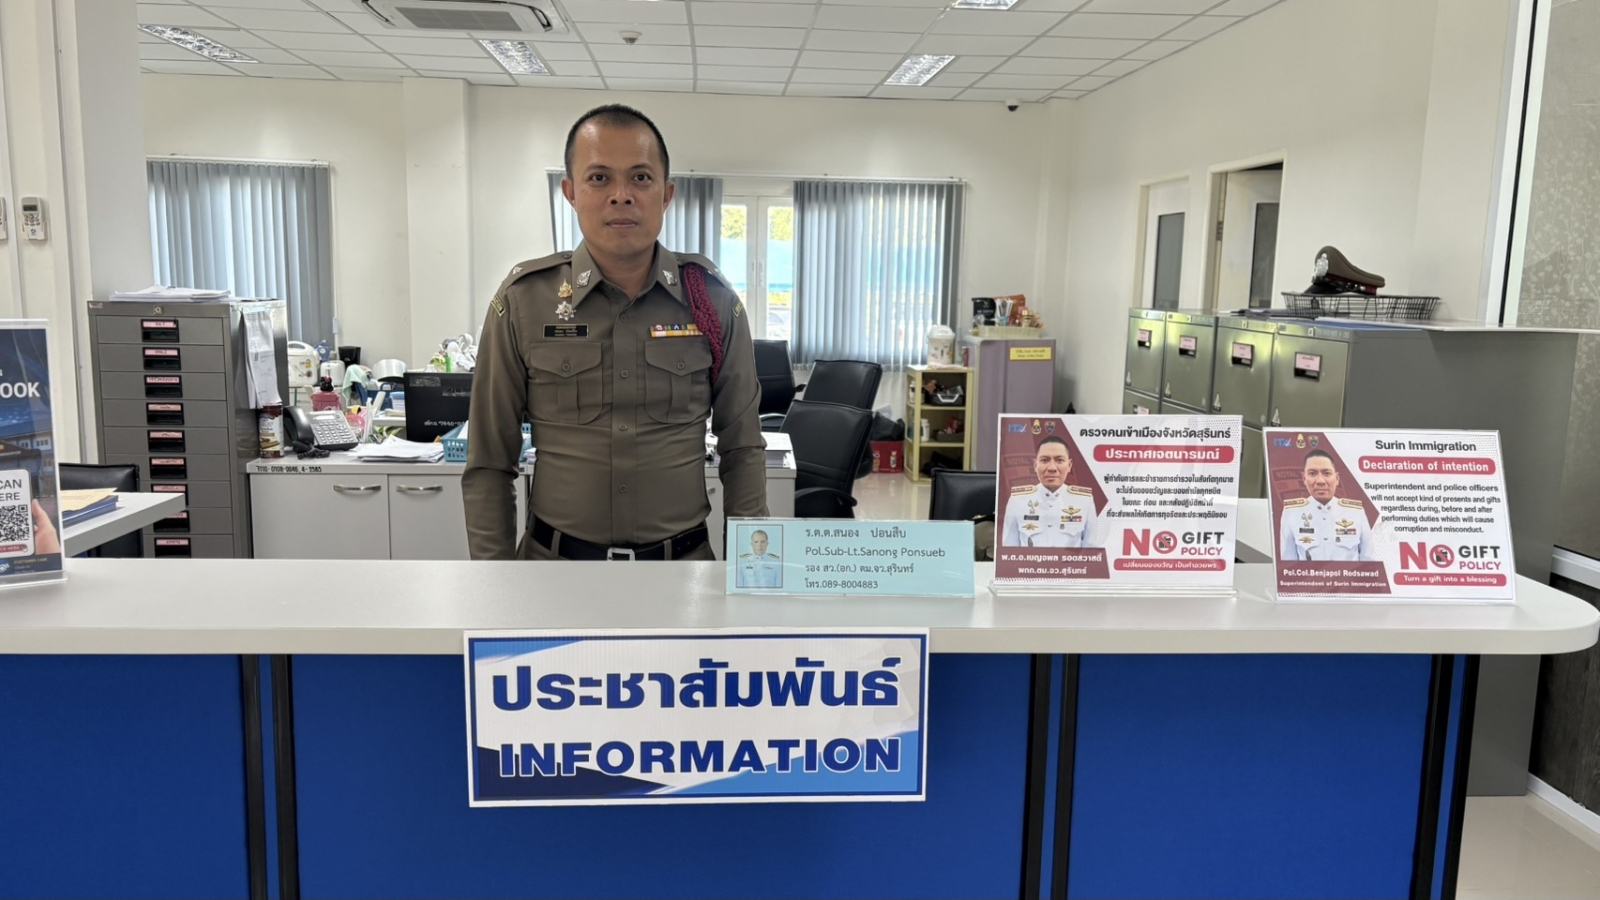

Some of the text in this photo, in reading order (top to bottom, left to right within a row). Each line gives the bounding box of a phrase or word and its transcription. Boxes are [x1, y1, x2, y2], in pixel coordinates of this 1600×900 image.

[1080, 426, 1231, 442] ตรวจคนเข้าเมืองจังหวัดสุรินทร์
[1375, 440, 1477, 453] Surin Immigration
[1105, 447, 1220, 460] ประกาศเจตนารมณ์
[1363, 459, 1488, 472] Declaration of intention
[1364, 482, 1498, 493] Superintendent and police officers
[1371, 494, 1382, 502] will
[1396, 495, 1418, 504] accept
[1443, 496, 1471, 505] presents
[1487, 496, 1501, 505] gifts
[1381, 505, 1416, 514] regardless
[1417, 505, 1440, 514] during,
[1442, 505, 1462, 513] before
[1478, 506, 1493, 514] after
[1381, 515, 1418, 524] performing
[1441, 515, 1460, 523] which
[1462, 515, 1473, 523] will
[1475, 516, 1494, 524] cause
[806, 528, 859, 538] ร.ต.ต.สนอง
[1394, 525, 1428, 534] corruption
[1430, 525, 1442, 533] and
[1181, 531, 1224, 545] GIFT
[806, 546, 945, 558] Pol.Sub-Lt.Sanong Ponsueb
[1181, 546, 1224, 556] POLICY
[1458, 545, 1500, 558] GIFT
[806, 564, 820, 573] รอง
[860, 563, 914, 575] ตม.จว.สุรินทร์
[1459, 561, 1501, 570] POLICY
[1283, 569, 1379, 578] Pol.Col.Benjapol Rodsawad
[805, 578, 878, 589] โทร.089-8004883
[1404, 575, 1420, 583] Turn
[1429, 576, 1442, 584] gift
[1466, 576, 1497, 584] blessing
[492, 656, 902, 712] ประชาสัมพันธ์
[500, 738, 902, 777] INFORMATION
